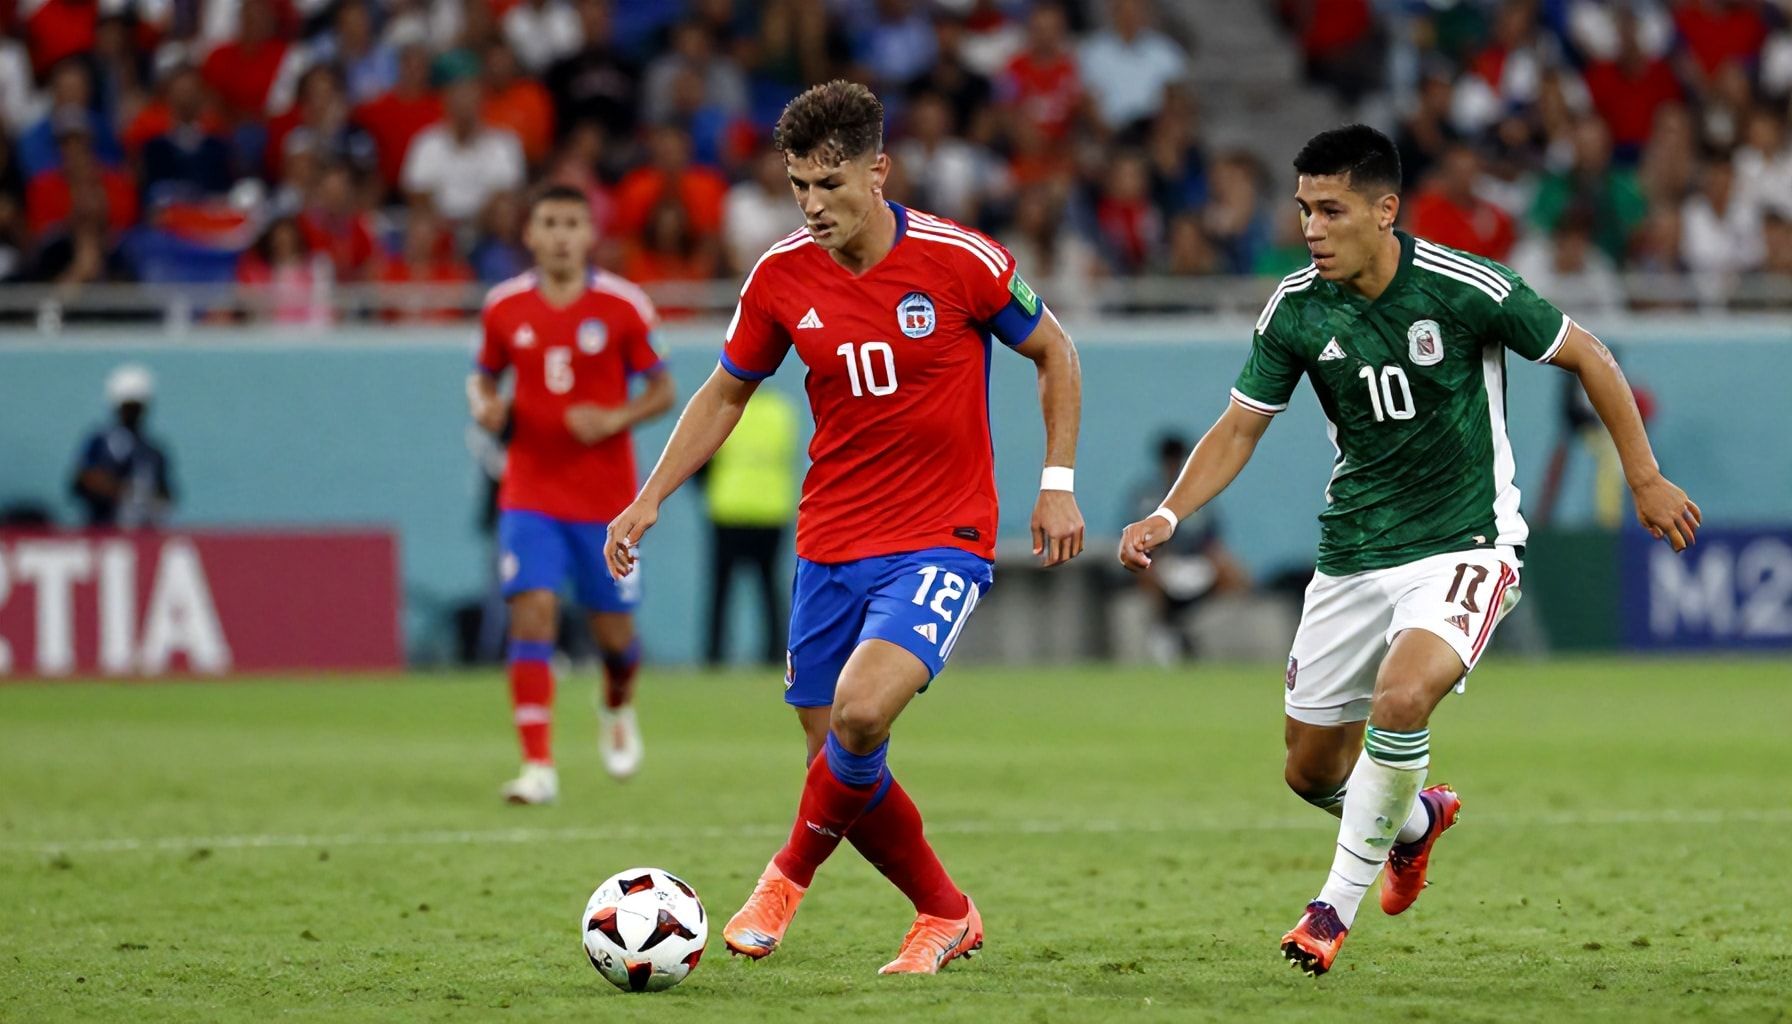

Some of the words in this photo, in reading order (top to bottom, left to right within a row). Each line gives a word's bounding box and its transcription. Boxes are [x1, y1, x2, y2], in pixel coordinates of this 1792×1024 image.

[836, 341, 898, 397] 10
[1358, 365, 1416, 422] 10
[0, 537, 233, 676] TIA
